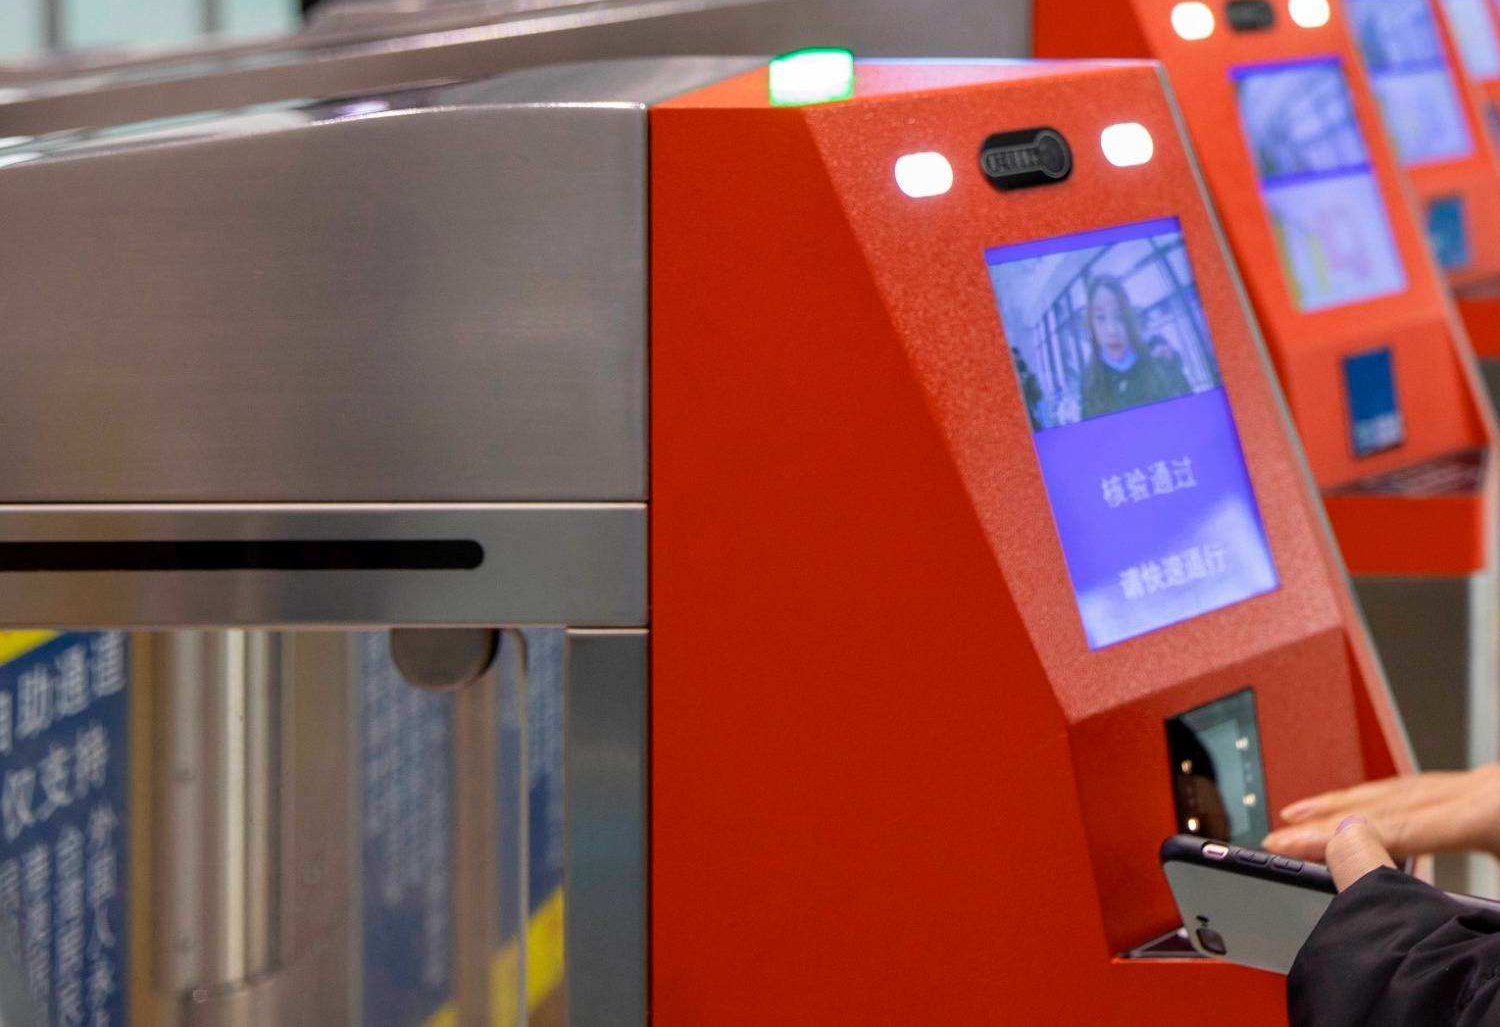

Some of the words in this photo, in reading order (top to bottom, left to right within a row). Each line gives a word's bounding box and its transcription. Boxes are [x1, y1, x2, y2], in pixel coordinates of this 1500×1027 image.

[1101, 455, 1198, 508] 核验通过
[1118, 542, 1227, 599] 请快速通行
